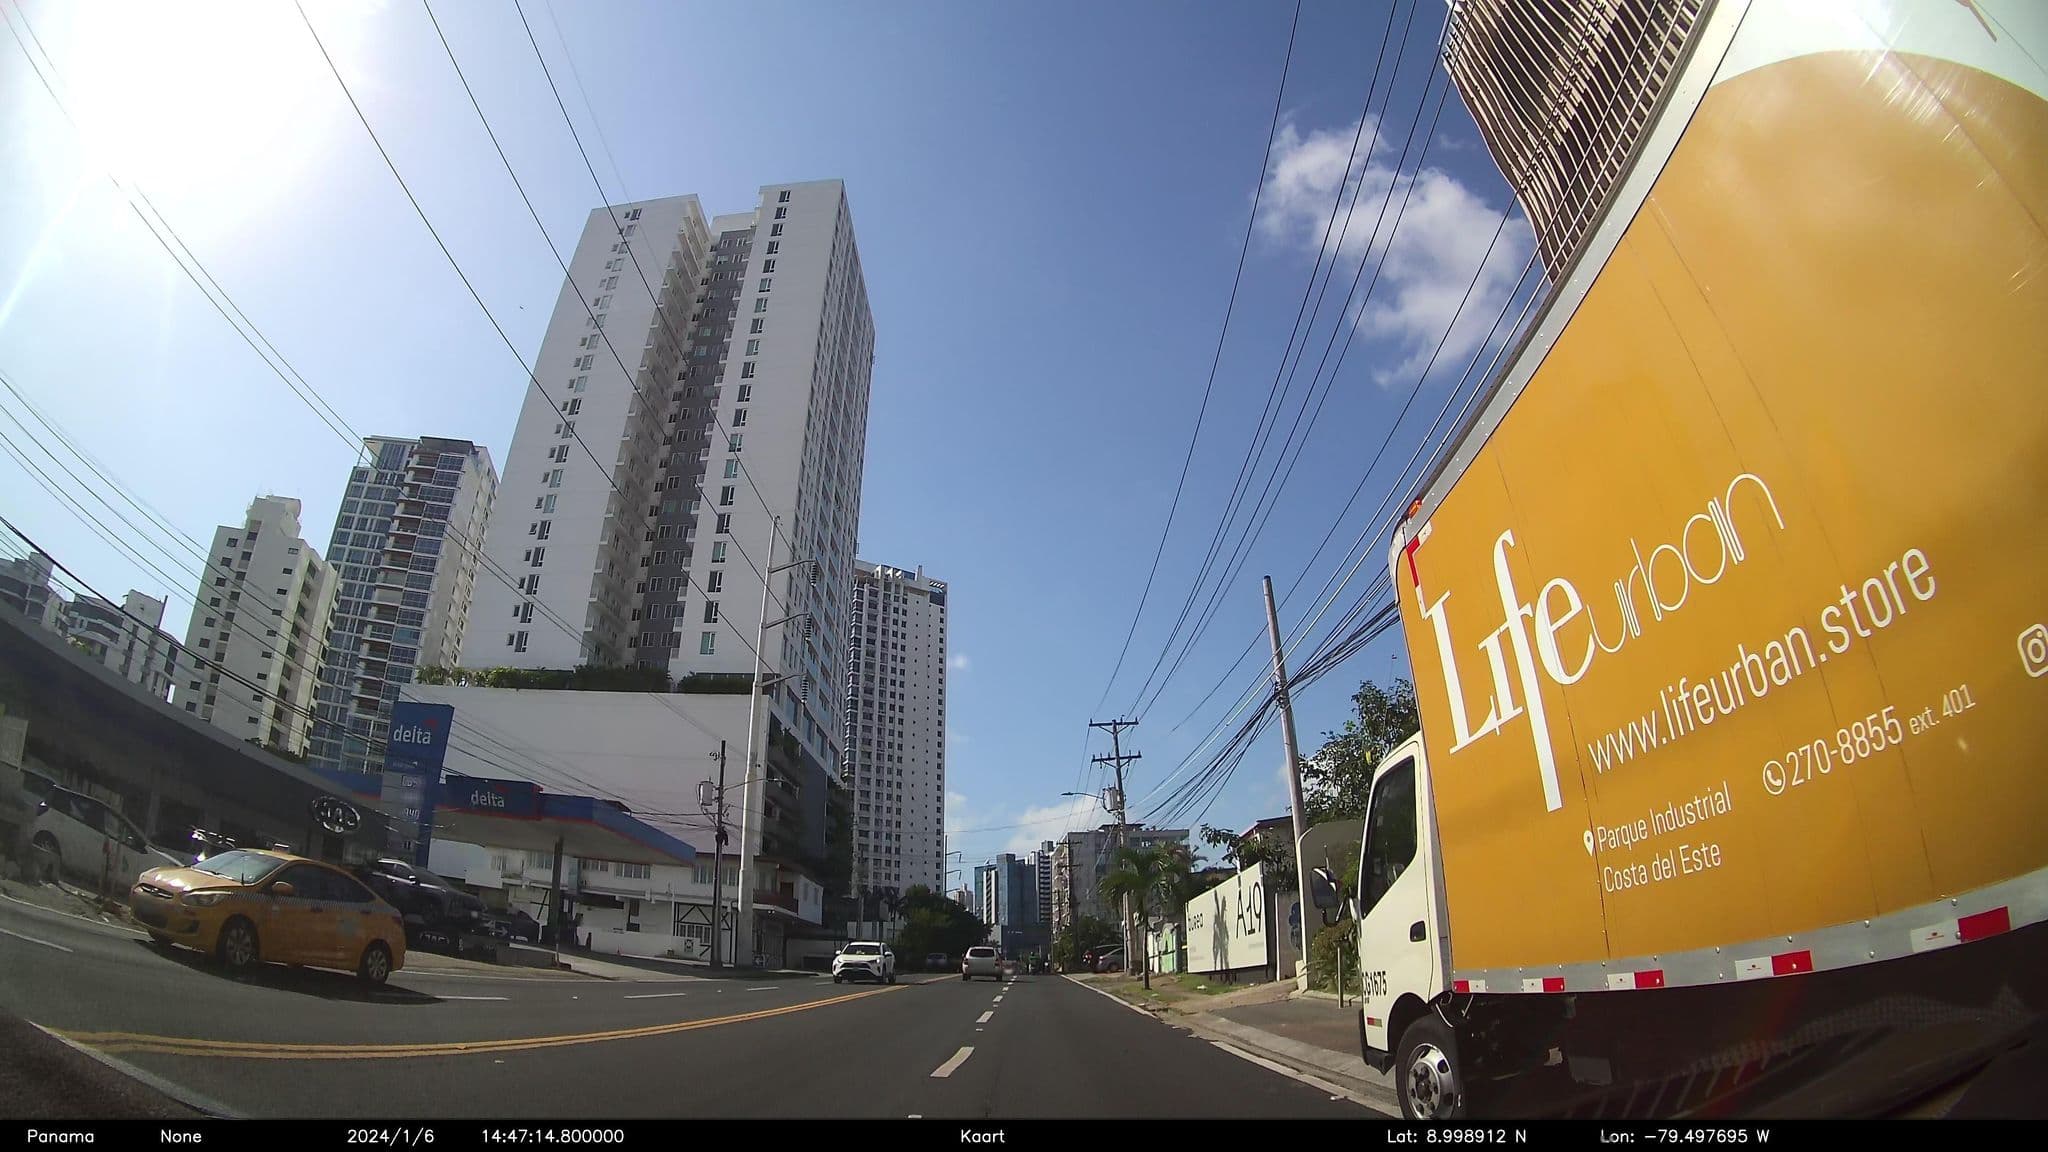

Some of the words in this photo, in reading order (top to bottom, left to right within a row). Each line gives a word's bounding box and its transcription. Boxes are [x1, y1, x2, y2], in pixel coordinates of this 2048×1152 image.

[1588, 548, 1936, 774] www.lifeurban.store
[393, 725, 431, 745] delta
[1786, 705, 1903, 787] 270-8855
[1909, 707, 1940, 735] ext.
[1941, 684, 1976, 719] 401
[471, 790, 505, 808] delta
[1597, 816, 1649, 852] Parque
[1650, 781, 1732, 836] Industrial
[1604, 862, 1649, 893] Costa
[1652, 849, 1676, 883] del
[1679, 841, 1721, 875] Este
[1236, 881, 1263, 939] A19
